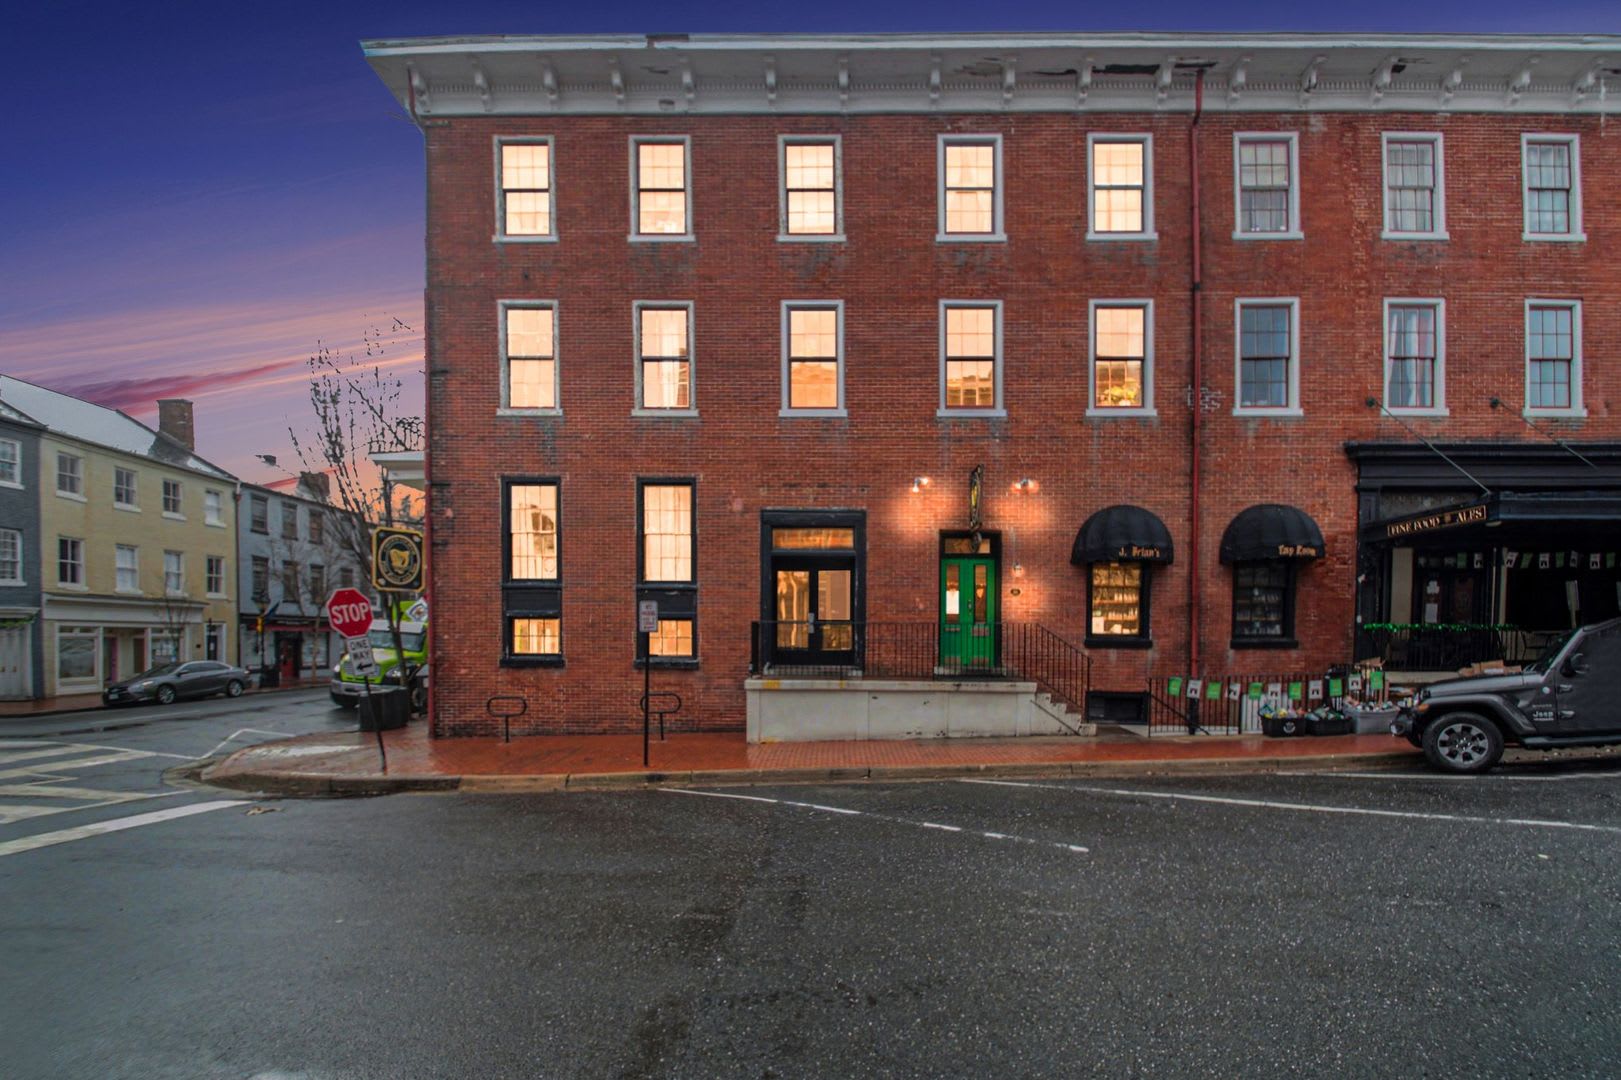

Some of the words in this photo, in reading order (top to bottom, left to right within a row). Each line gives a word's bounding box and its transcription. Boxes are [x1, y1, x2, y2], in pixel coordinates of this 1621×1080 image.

[1457, 508, 1482, 523] ALES
[331, 602, 369, 625] STOP
[350, 639, 369, 650] ONE
[353, 651, 370, 660] WAY
